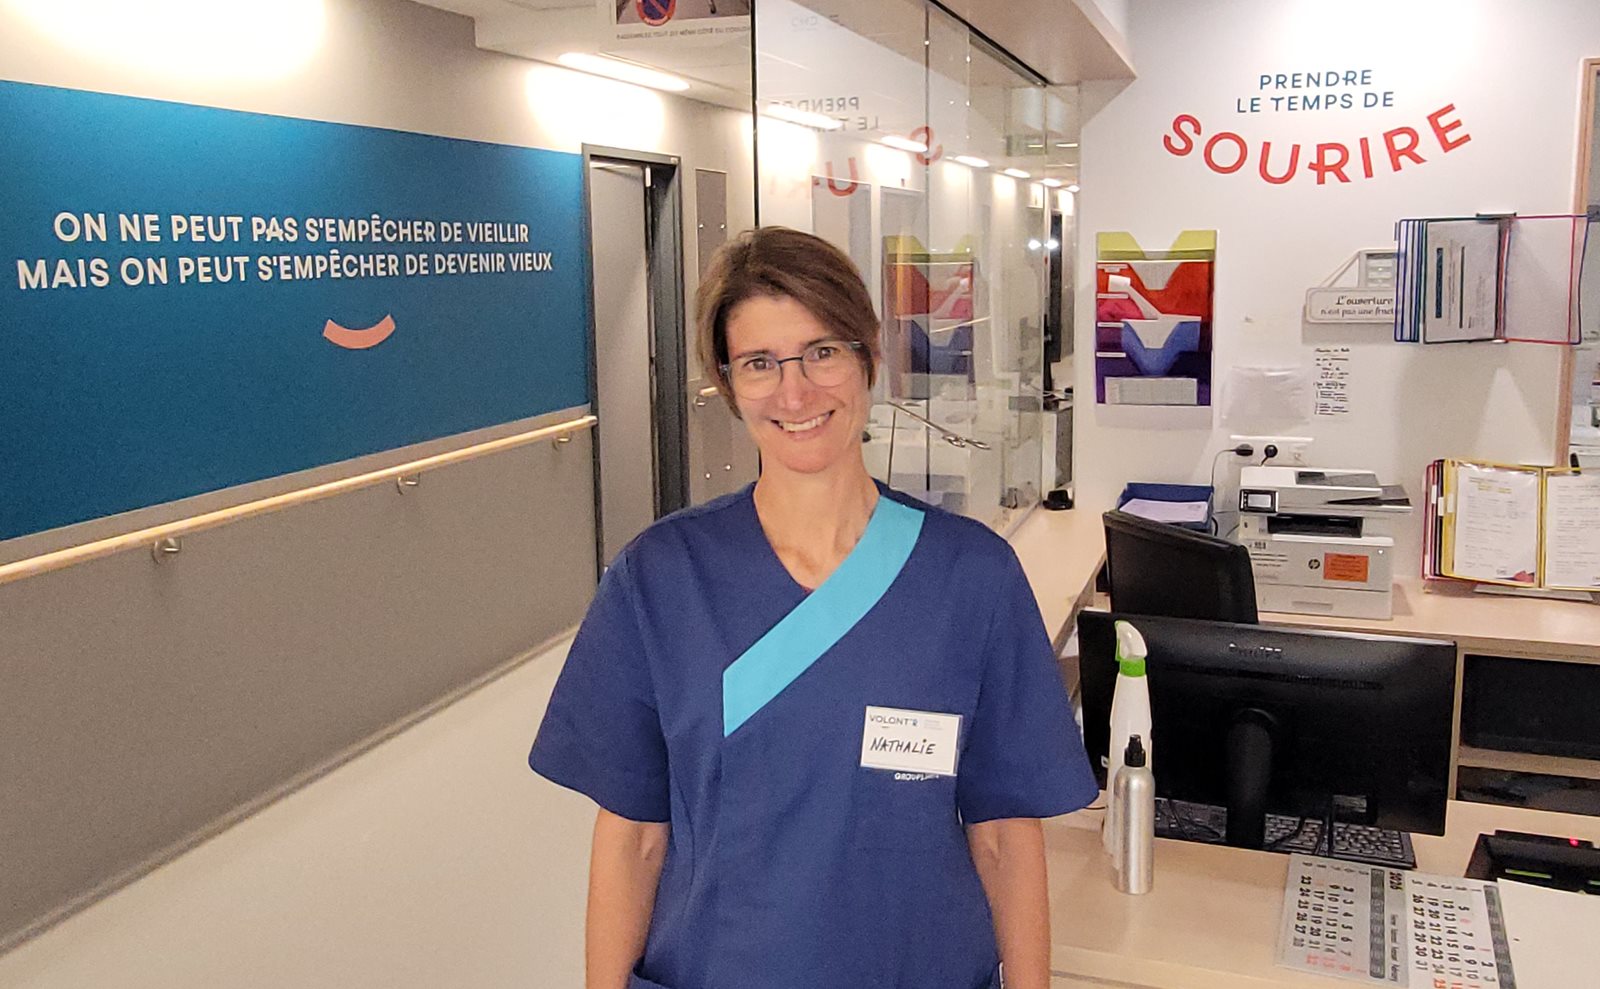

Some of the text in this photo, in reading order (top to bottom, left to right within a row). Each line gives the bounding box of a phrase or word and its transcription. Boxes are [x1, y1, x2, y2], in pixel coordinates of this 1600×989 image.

[1259, 69, 1372, 90] PRENDRE
[1237, 91, 1394, 113] LE TEMPS DE
[1163, 103, 1472, 186] SOURIRE
[53, 212, 529, 243] ON NE PEUT PAS S'EMPÊCHER DE VIEILLIR
[17, 249, 553, 290] MAIS ON PEUT S'EMPÊCHER DE DEVENIR VIEUX
